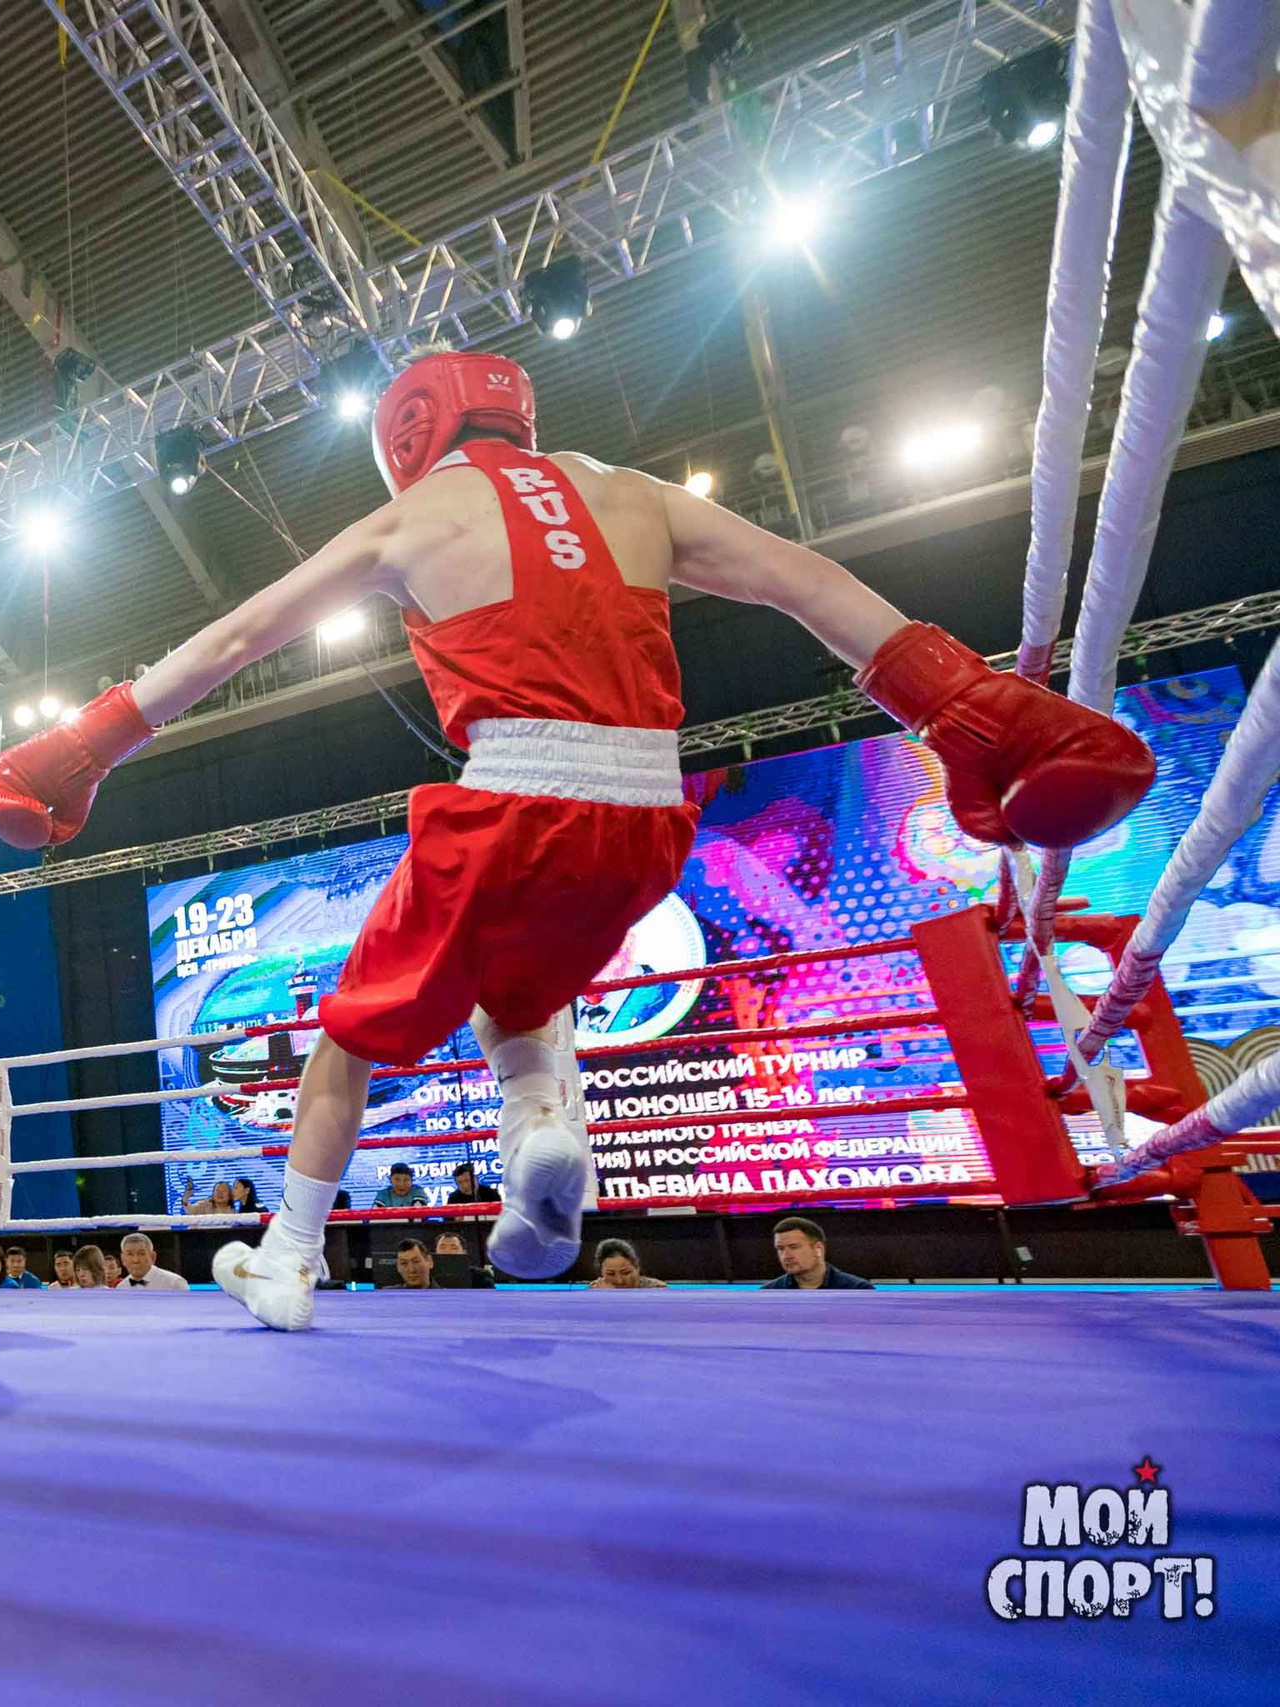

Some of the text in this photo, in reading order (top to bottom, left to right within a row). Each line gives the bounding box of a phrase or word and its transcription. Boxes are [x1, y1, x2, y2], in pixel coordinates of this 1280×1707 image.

[499, 467, 587, 570] RUS
[174, 893, 254, 938] 19-23
[176, 926, 258, 964] ДЕКАБРЯ
[413, 1047, 868, 1103] ОТКРЫТ РОССИЙСКИЙ ТУРНИР
[426, 1117, 451, 1131] по
[454, 1108, 502, 1129] БОК
[614, 1086, 739, 1118] ЮНОШЕЙ
[817, 1085, 866, 1104] лет
[589, 1118, 815, 1147] ЛУЖЕННОГО ТРЕНЕРА
[634, 1149, 651, 1167] И
[653, 1137, 811, 1166] РОССИЙСКОЙ
[813, 1136, 963, 1158] ФЕДЕРАЦИИ
[604, 1165, 972, 1199] ТЬЕВИЧА ПАХОМОВА
